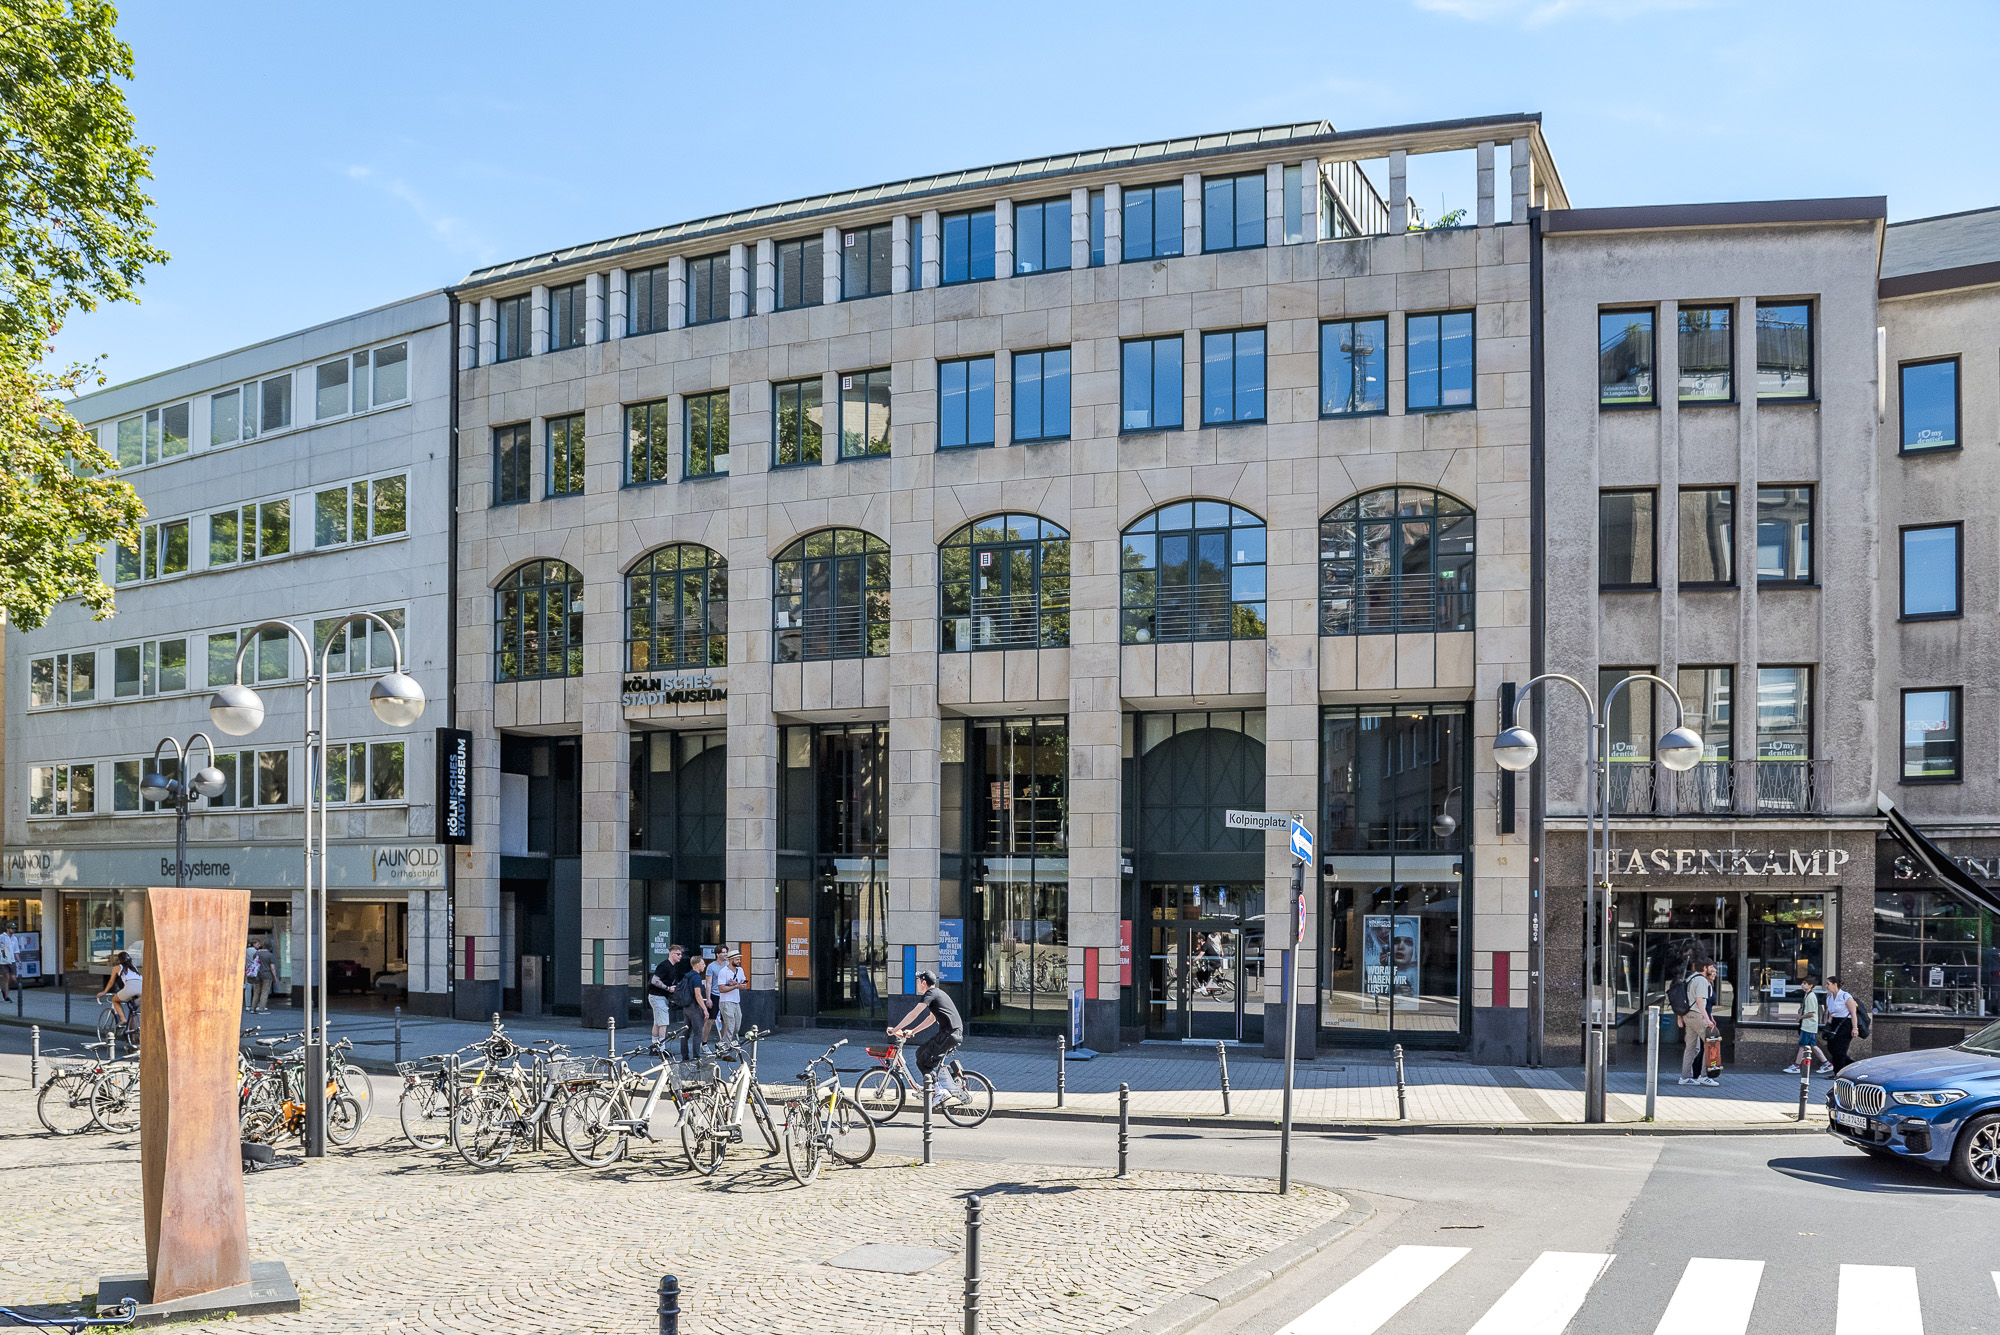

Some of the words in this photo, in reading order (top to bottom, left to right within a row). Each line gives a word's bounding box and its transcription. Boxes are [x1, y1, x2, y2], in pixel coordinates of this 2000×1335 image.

[622, 675, 713, 692] KÖLNISCHES
[622, 688, 728, 706] STADTMUSEUM
[1768, 749, 1796, 757] dentist!
[1782, 743, 1795, 751] my
[446, 753, 458, 837] KÖLNISCHES
[457, 738, 467, 837] STADTMUSEUM
[1229, 813, 1287, 828] Kolpingplatz
[11, 855, 51, 870] AUNOLD
[377, 848, 439, 867] AUNOLD
[1497, 856, 1508, 866] 13
[1593, 848, 1850, 876] HASENKAMP
[161, 857, 230, 881] Besysteme
[390, 869, 439, 878] Orthoschlaf
[1367, 975, 1391, 984] HABEN
[1393, 975, 1407, 985] WIR
[1367, 984, 1389, 994] LUST?
